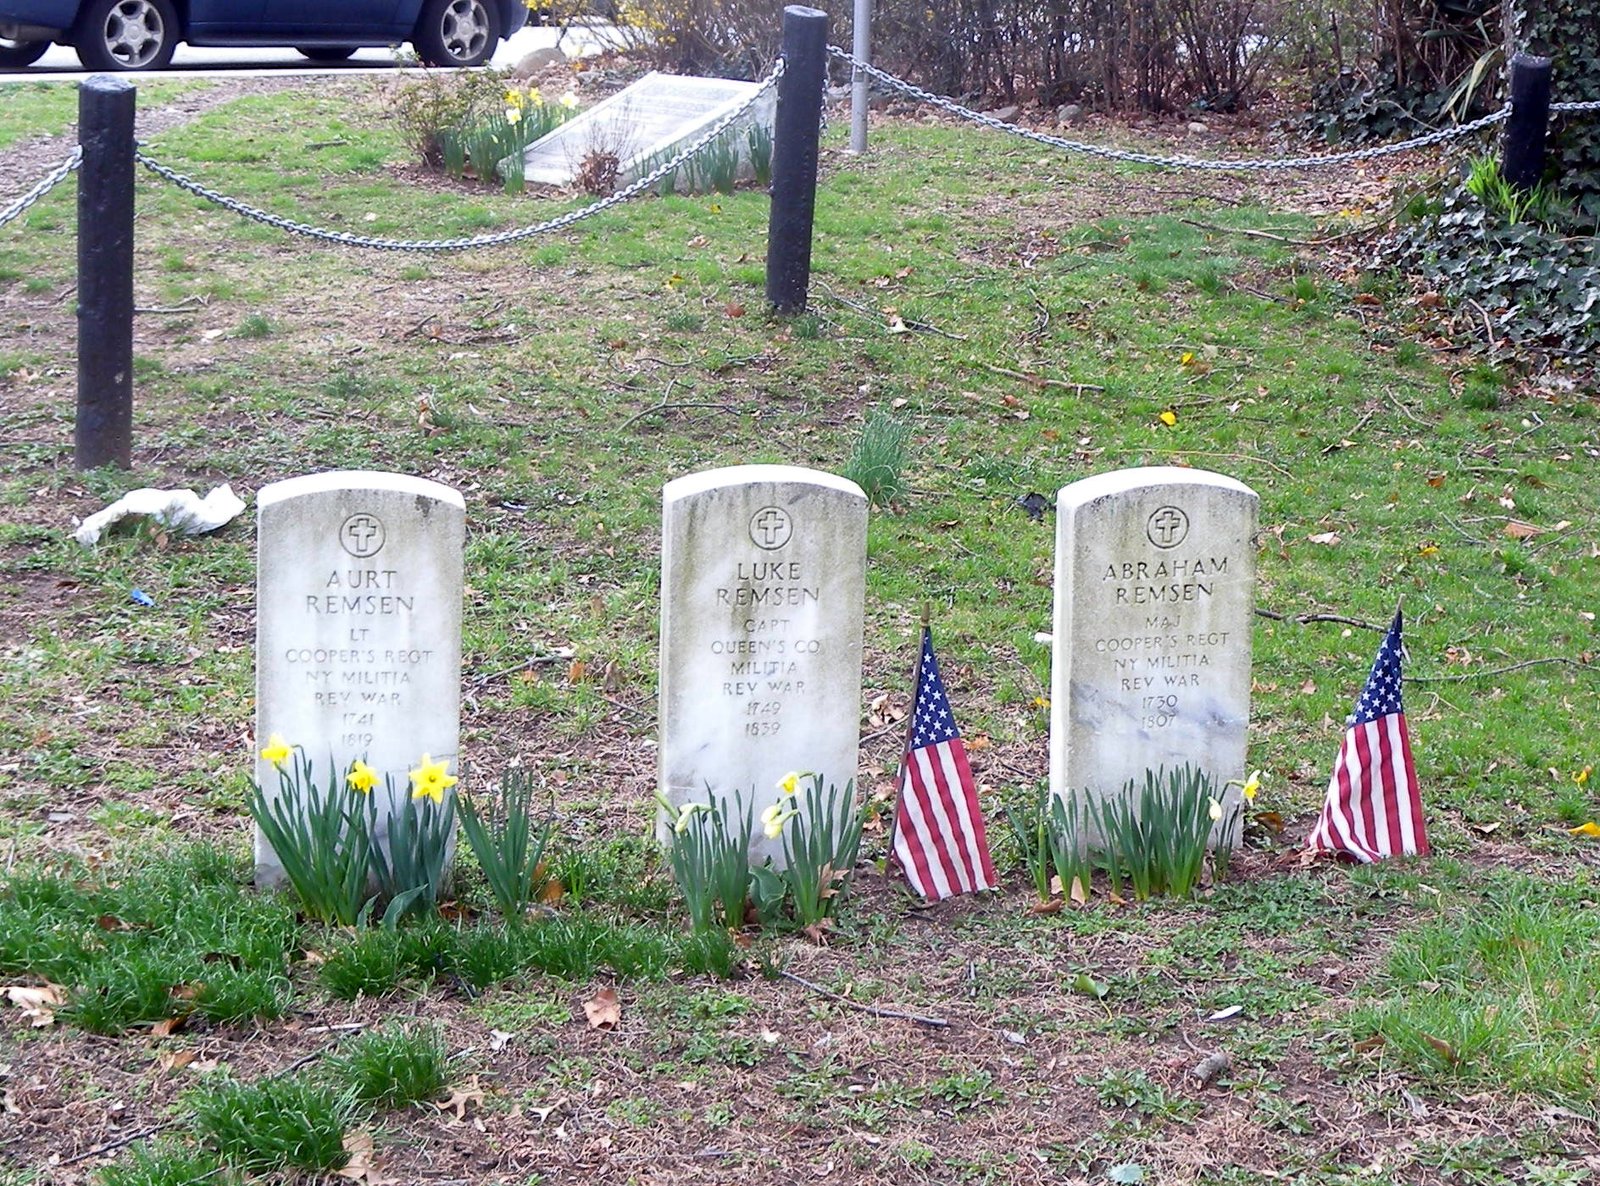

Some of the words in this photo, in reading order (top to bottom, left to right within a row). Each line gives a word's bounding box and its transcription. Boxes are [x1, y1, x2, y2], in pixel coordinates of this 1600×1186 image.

[738, 563, 800, 581] LUKE
[1103, 558, 1228, 581] ABRAHAM
[326, 570, 397, 588] AURT
[717, 588, 819, 605] REMSEN
[1117, 584, 1213, 604] REMSEN
[307, 596, 413, 614] REMSEN
[743, 619, 790, 632] CAPT
[1145, 617, 1181, 629] MAJ
[350, 629, 369, 641] LT
[1096, 636, 1177, 652] COOPER'S
[1187, 633, 1229, 646] REGT
[711, 640, 785, 654] QUEEN'S
[794, 640, 820, 654] CO
[285, 650, 375, 663] COOPER'S
[386, 650, 434, 663] REGT
[1114, 658, 1137, 671] NY
[1147, 655, 1209, 669] MILITIA
[731, 662, 797, 675] MILITIA
[307, 670, 330, 683] NY
[343, 671, 410, 683] MILITIA
[1122, 677, 1154, 691] REV
[1165, 675, 1199, 687] WAR
[723, 683, 758, 695] REV
[768, 681, 805, 694] WAR
[315, 692, 351, 705] REV
[361, 692, 400, 705] WAR
